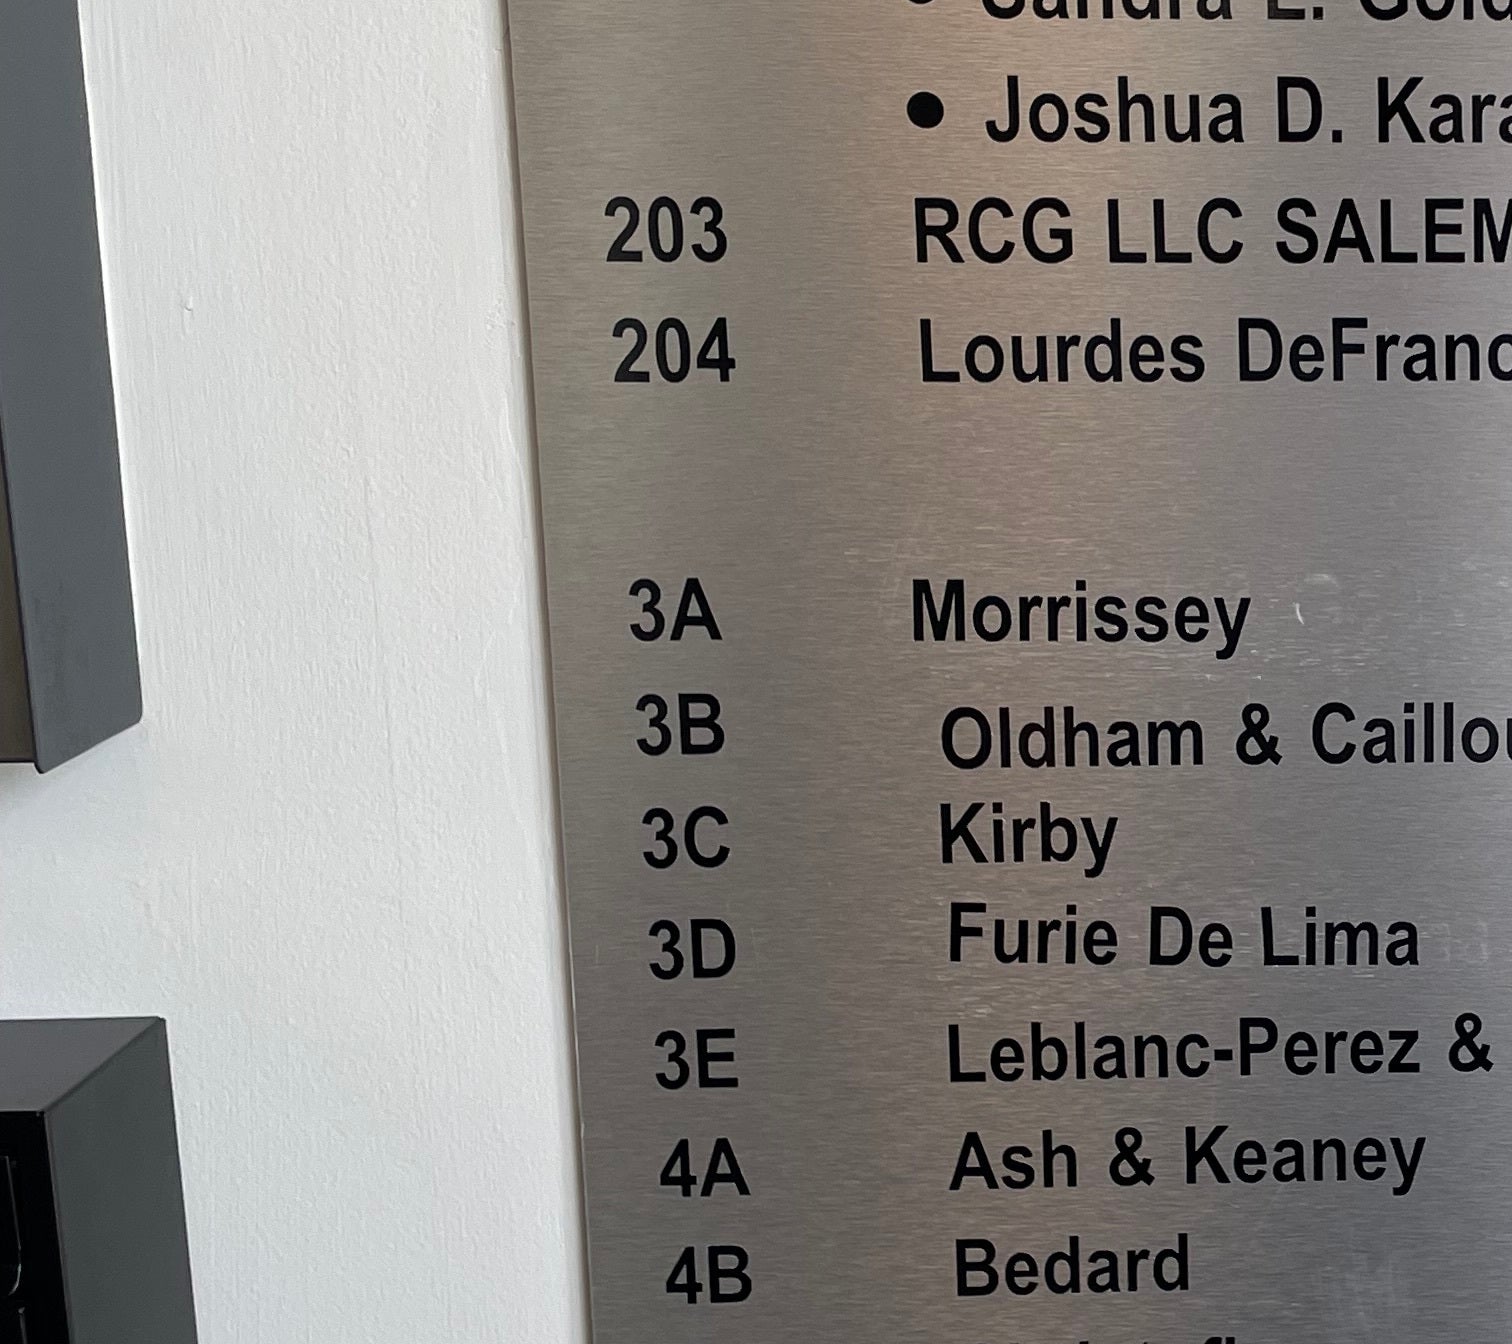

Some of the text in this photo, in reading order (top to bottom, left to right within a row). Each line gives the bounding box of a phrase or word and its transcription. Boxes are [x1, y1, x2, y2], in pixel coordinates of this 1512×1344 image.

[985, 74, 1245, 144] Joshua
[1276, 75, 1343, 144] D.
[604, 195, 728, 264] 203
[914, 196, 1074, 265] RCG
[1106, 197, 1244, 265] LLC
[611, 316, 737, 384] 204
[919, 317, 1205, 384] Lourdes
[628, 577, 723, 642] 3A
[912, 578, 1252, 660] Morrissey
[635, 692, 725, 757] 3B
[941, 705, 1204, 770] Oldham
[1235, 702, 1283, 766] &
[641, 805, 731, 870] 3C
[939, 801, 1119, 879] Kirby
[648, 918, 736, 981] 3D
[949, 901, 1420, 968] Furie De Lima
[654, 1028, 739, 1091] 3E
[948, 1017, 1421, 1083] Leblanc-Perez
[1448, 1012, 1495, 1073] &
[659, 1137, 752, 1198] 4A
[948, 1125, 1427, 1197] Ash & Keaney
[665, 1245, 753, 1305] 4B
[955, 1232, 1190, 1297] Bedard
